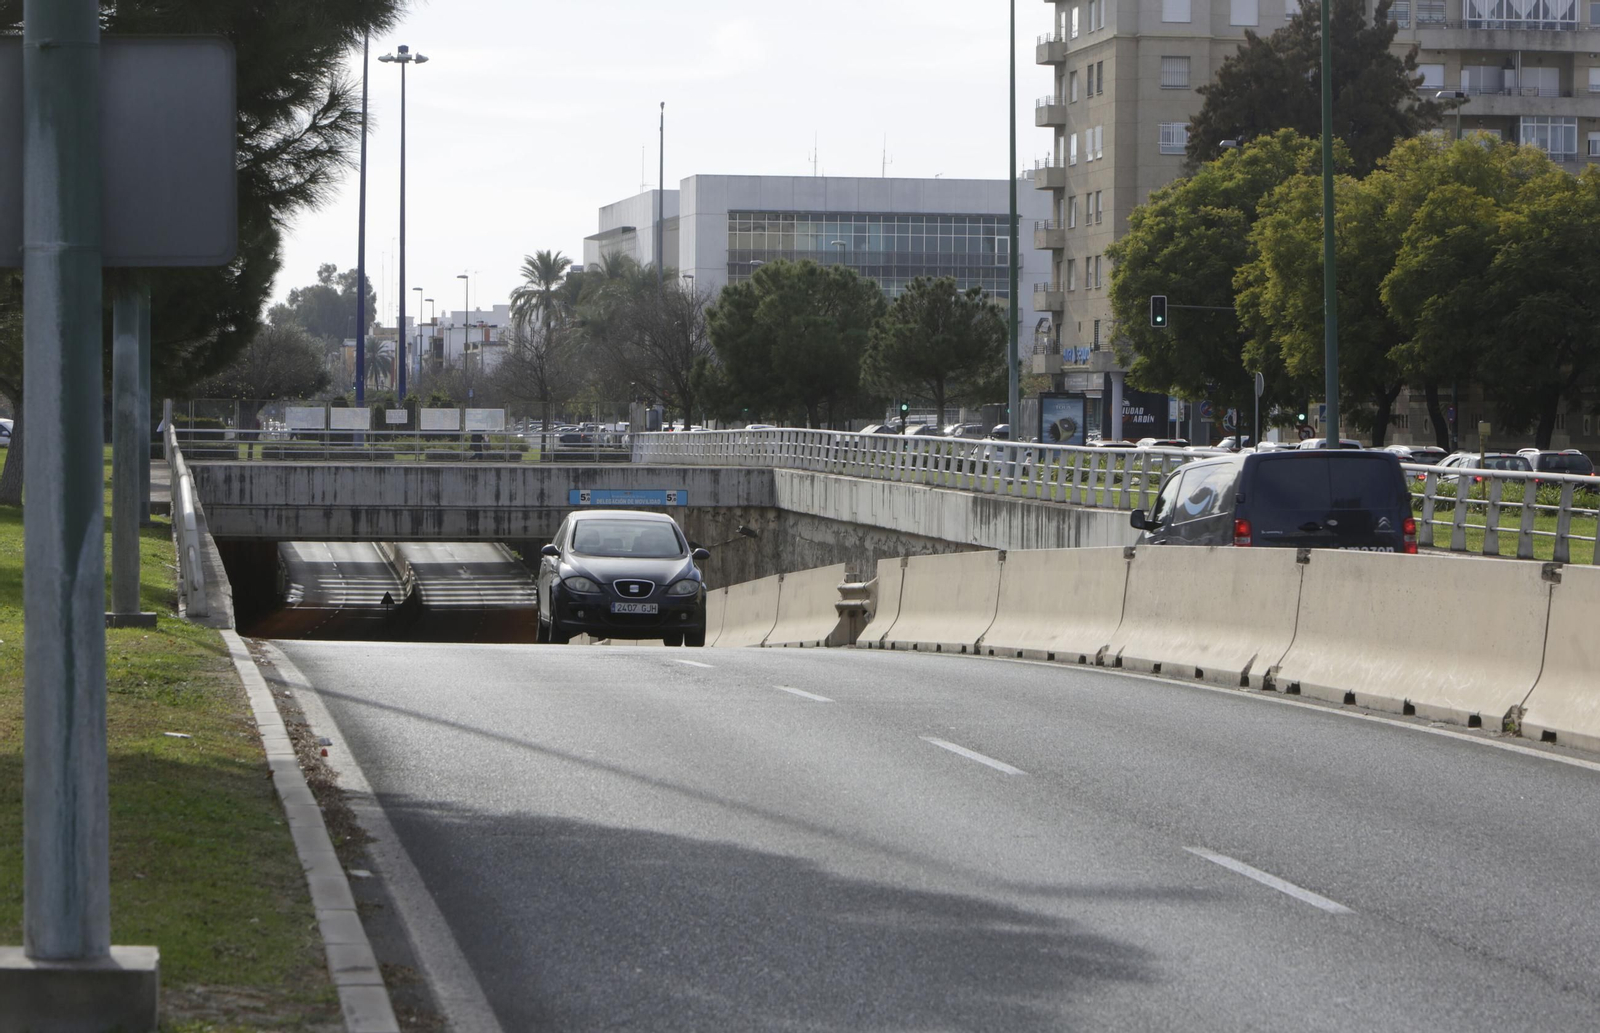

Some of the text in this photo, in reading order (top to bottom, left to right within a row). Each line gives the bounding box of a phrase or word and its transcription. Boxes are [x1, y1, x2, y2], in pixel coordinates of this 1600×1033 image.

[1122, 407, 1144, 415] IUDAD
[617, 604, 657, 613] 2407 GJH
